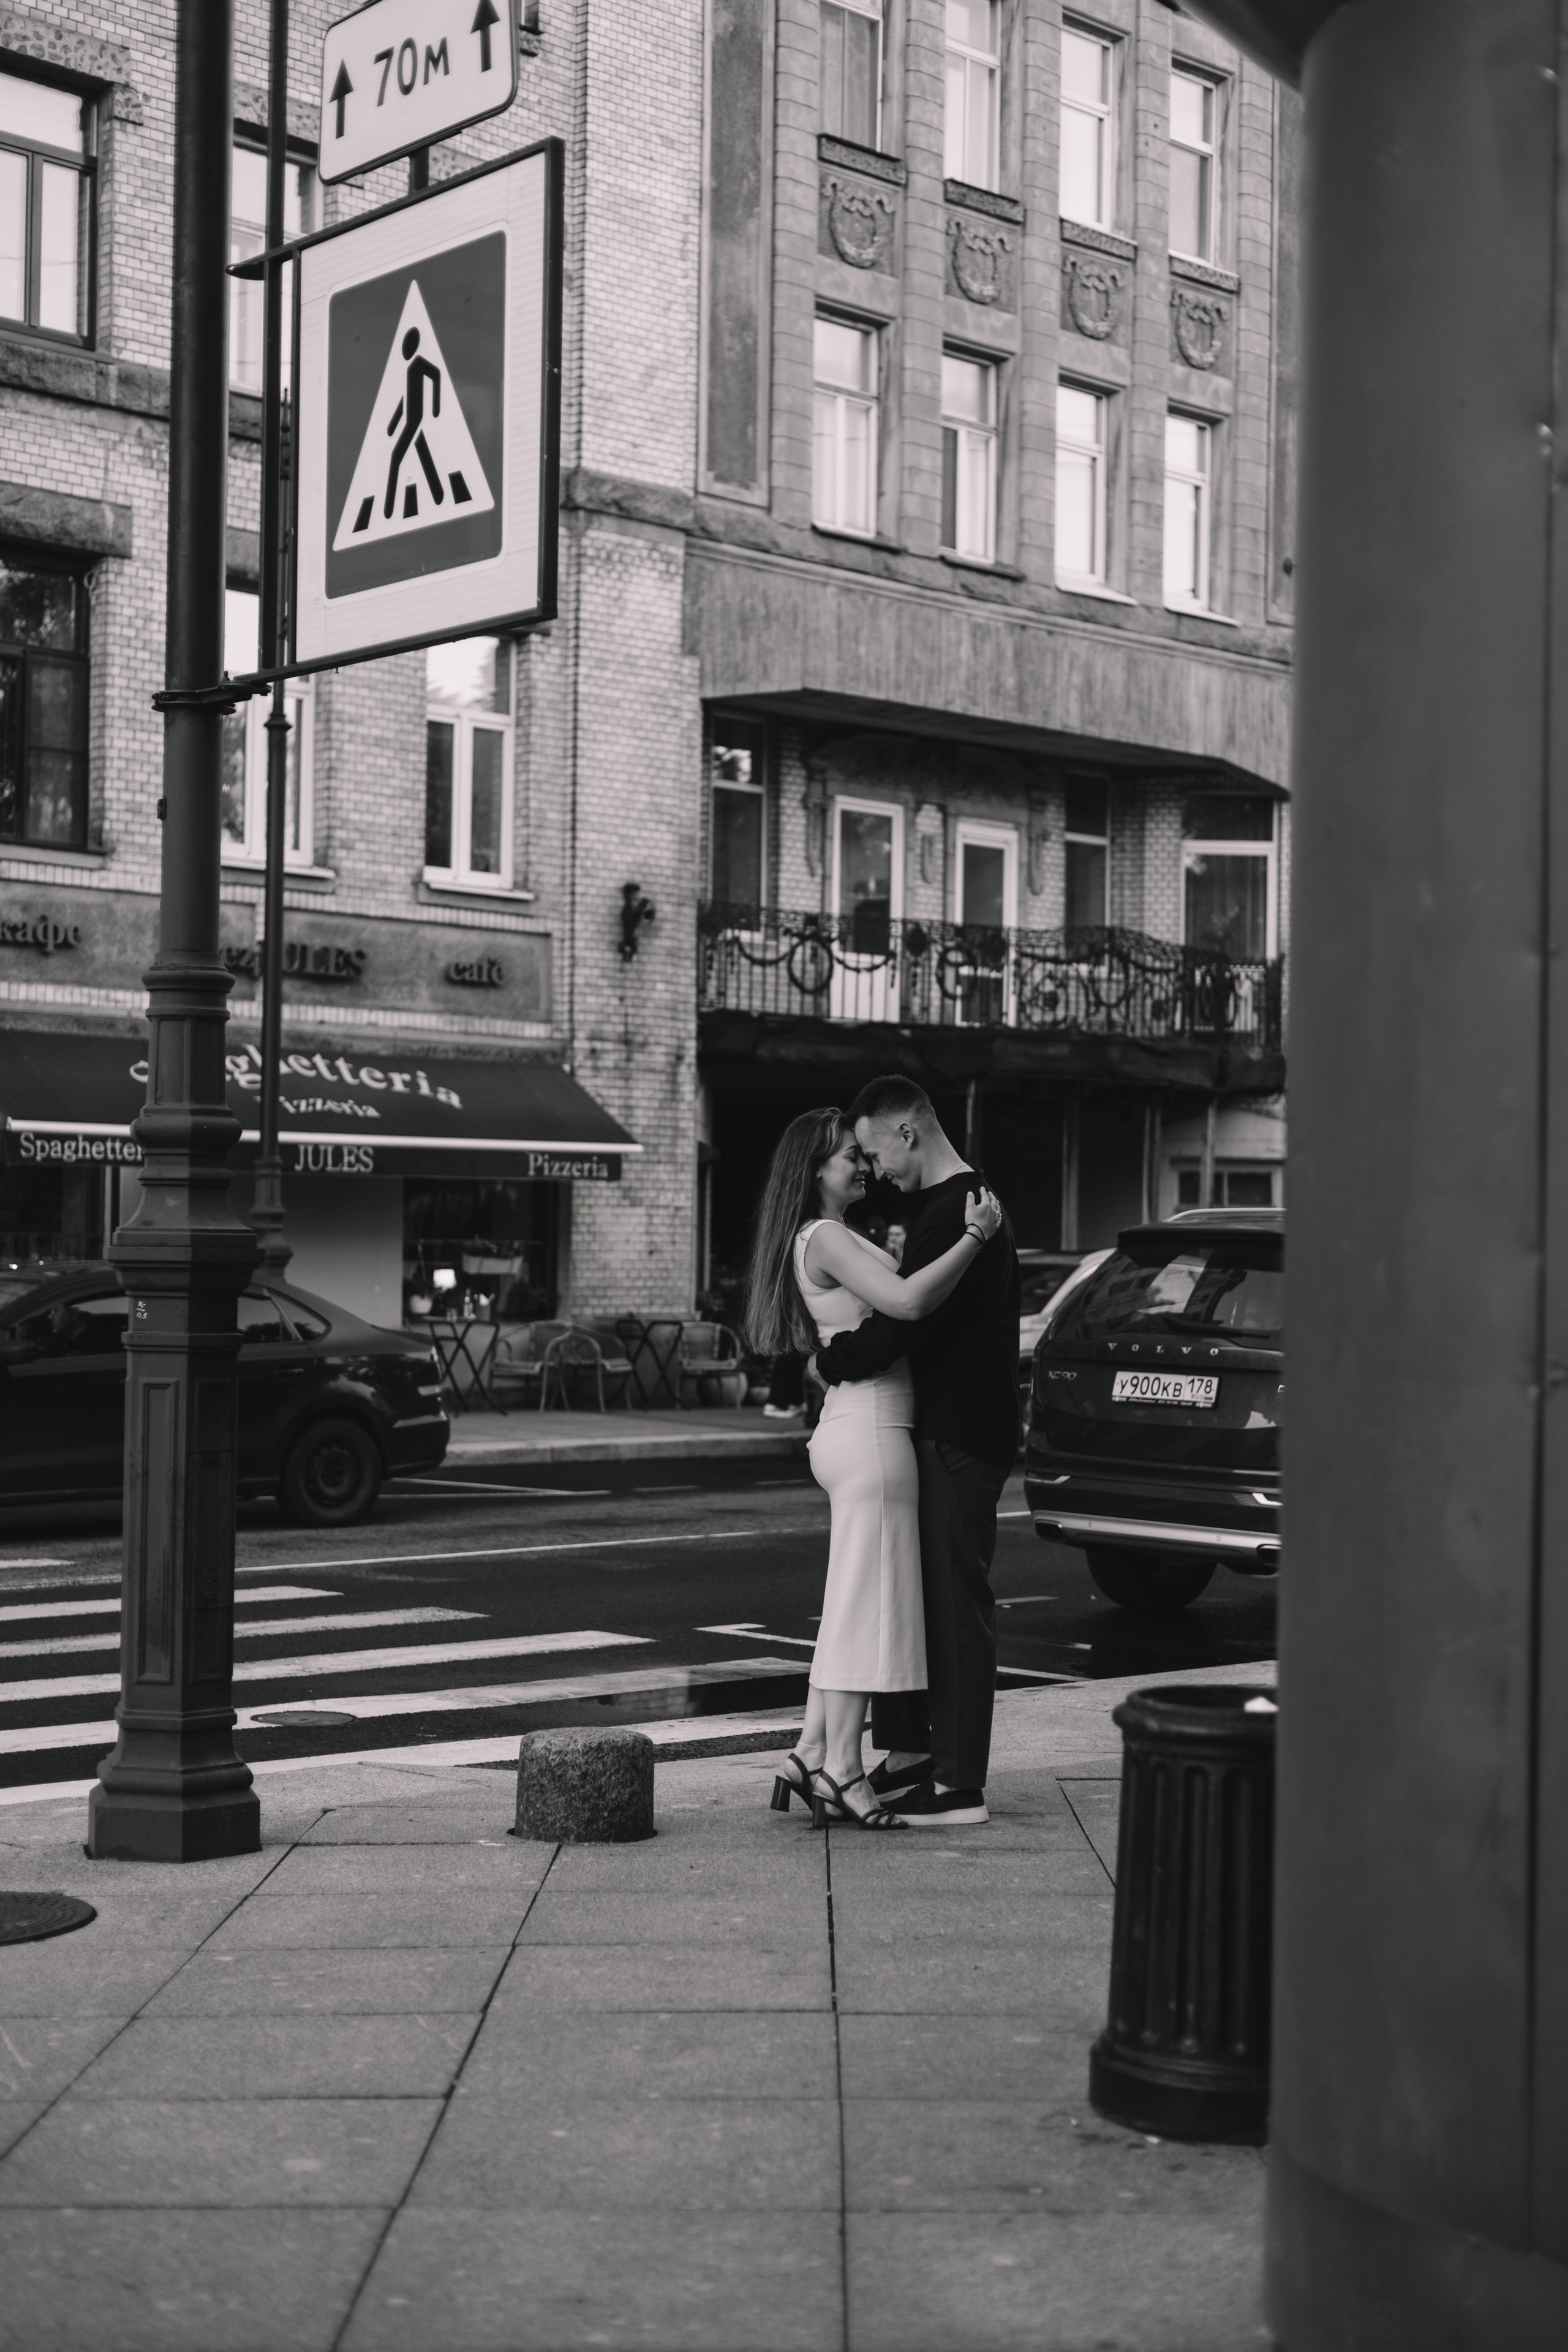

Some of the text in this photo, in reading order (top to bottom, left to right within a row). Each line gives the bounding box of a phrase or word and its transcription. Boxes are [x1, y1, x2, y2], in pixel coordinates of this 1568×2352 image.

[282, 943, 368, 977] ULES
[252, 1095, 382, 1120] izzeria
[295, 1144, 374, 1173] JULES
[527, 1152, 608, 1177] Pizzeria
[1108, 1343, 1219, 1356] VOLVO
[1188, 1378, 1213, 1395] 178
